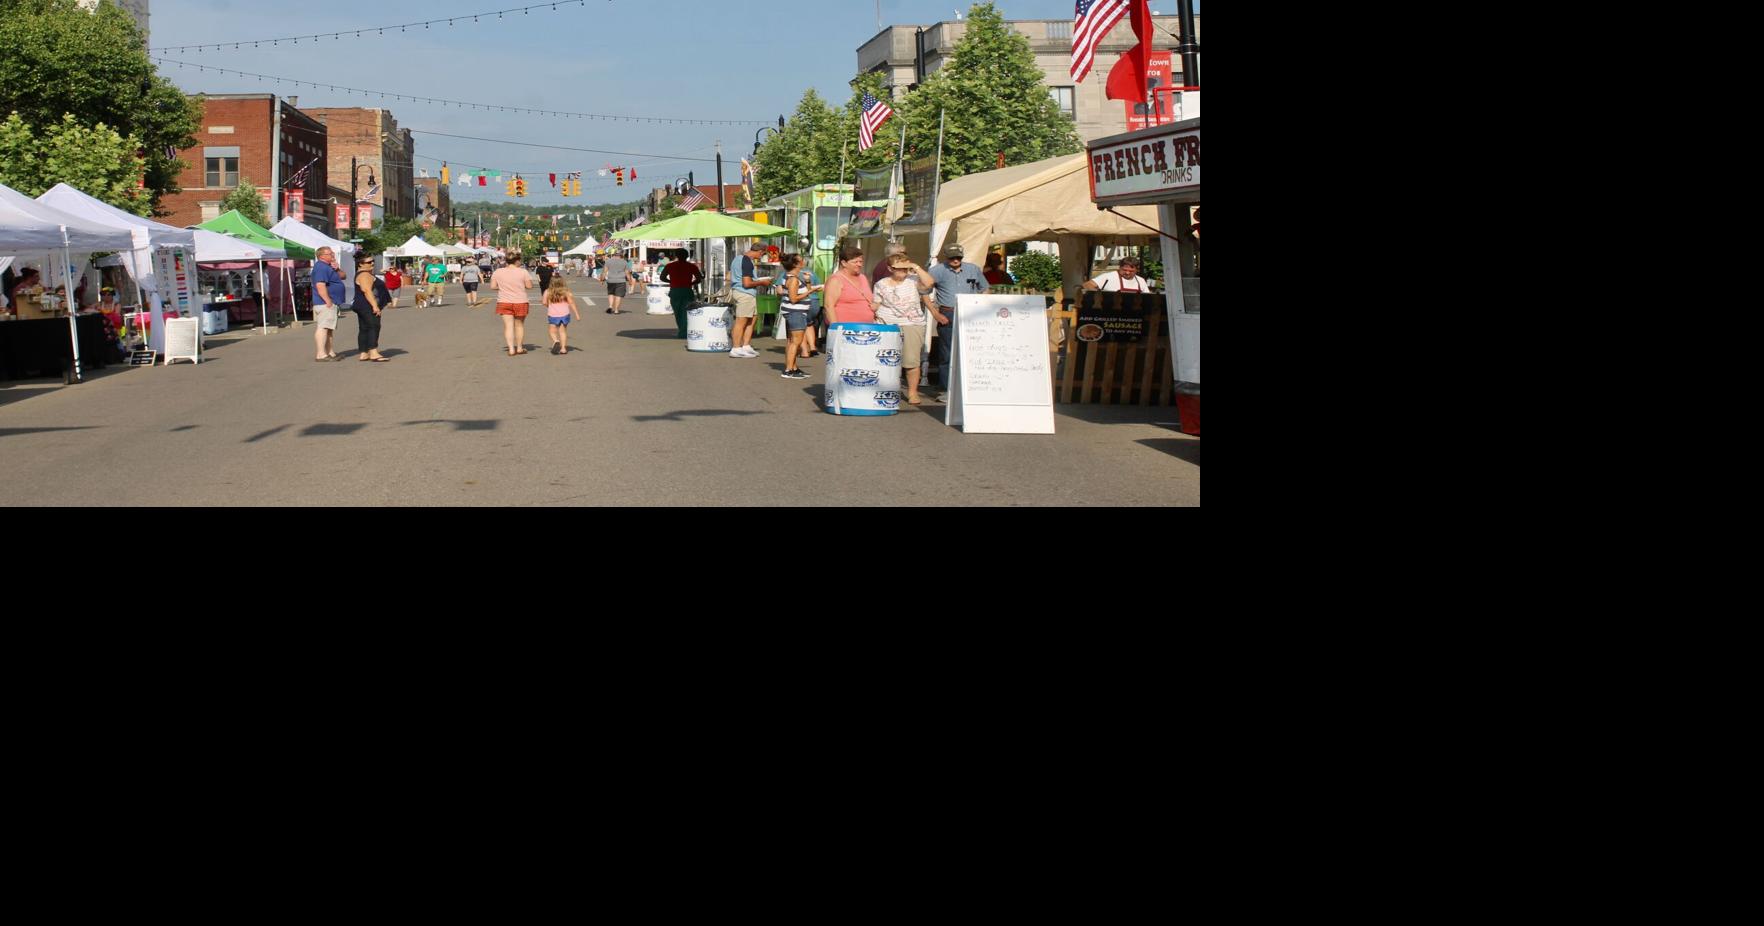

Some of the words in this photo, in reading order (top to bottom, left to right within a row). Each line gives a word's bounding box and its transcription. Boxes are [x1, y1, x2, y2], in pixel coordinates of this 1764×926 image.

[1093, 141, 1168, 183] FRENCH
[1173, 135, 1200, 168] FR
[1162, 167, 1193, 184] DRINKS
[1103, 321, 1142, 329] SAUSAGE
[840, 368, 880, 379] KPS
